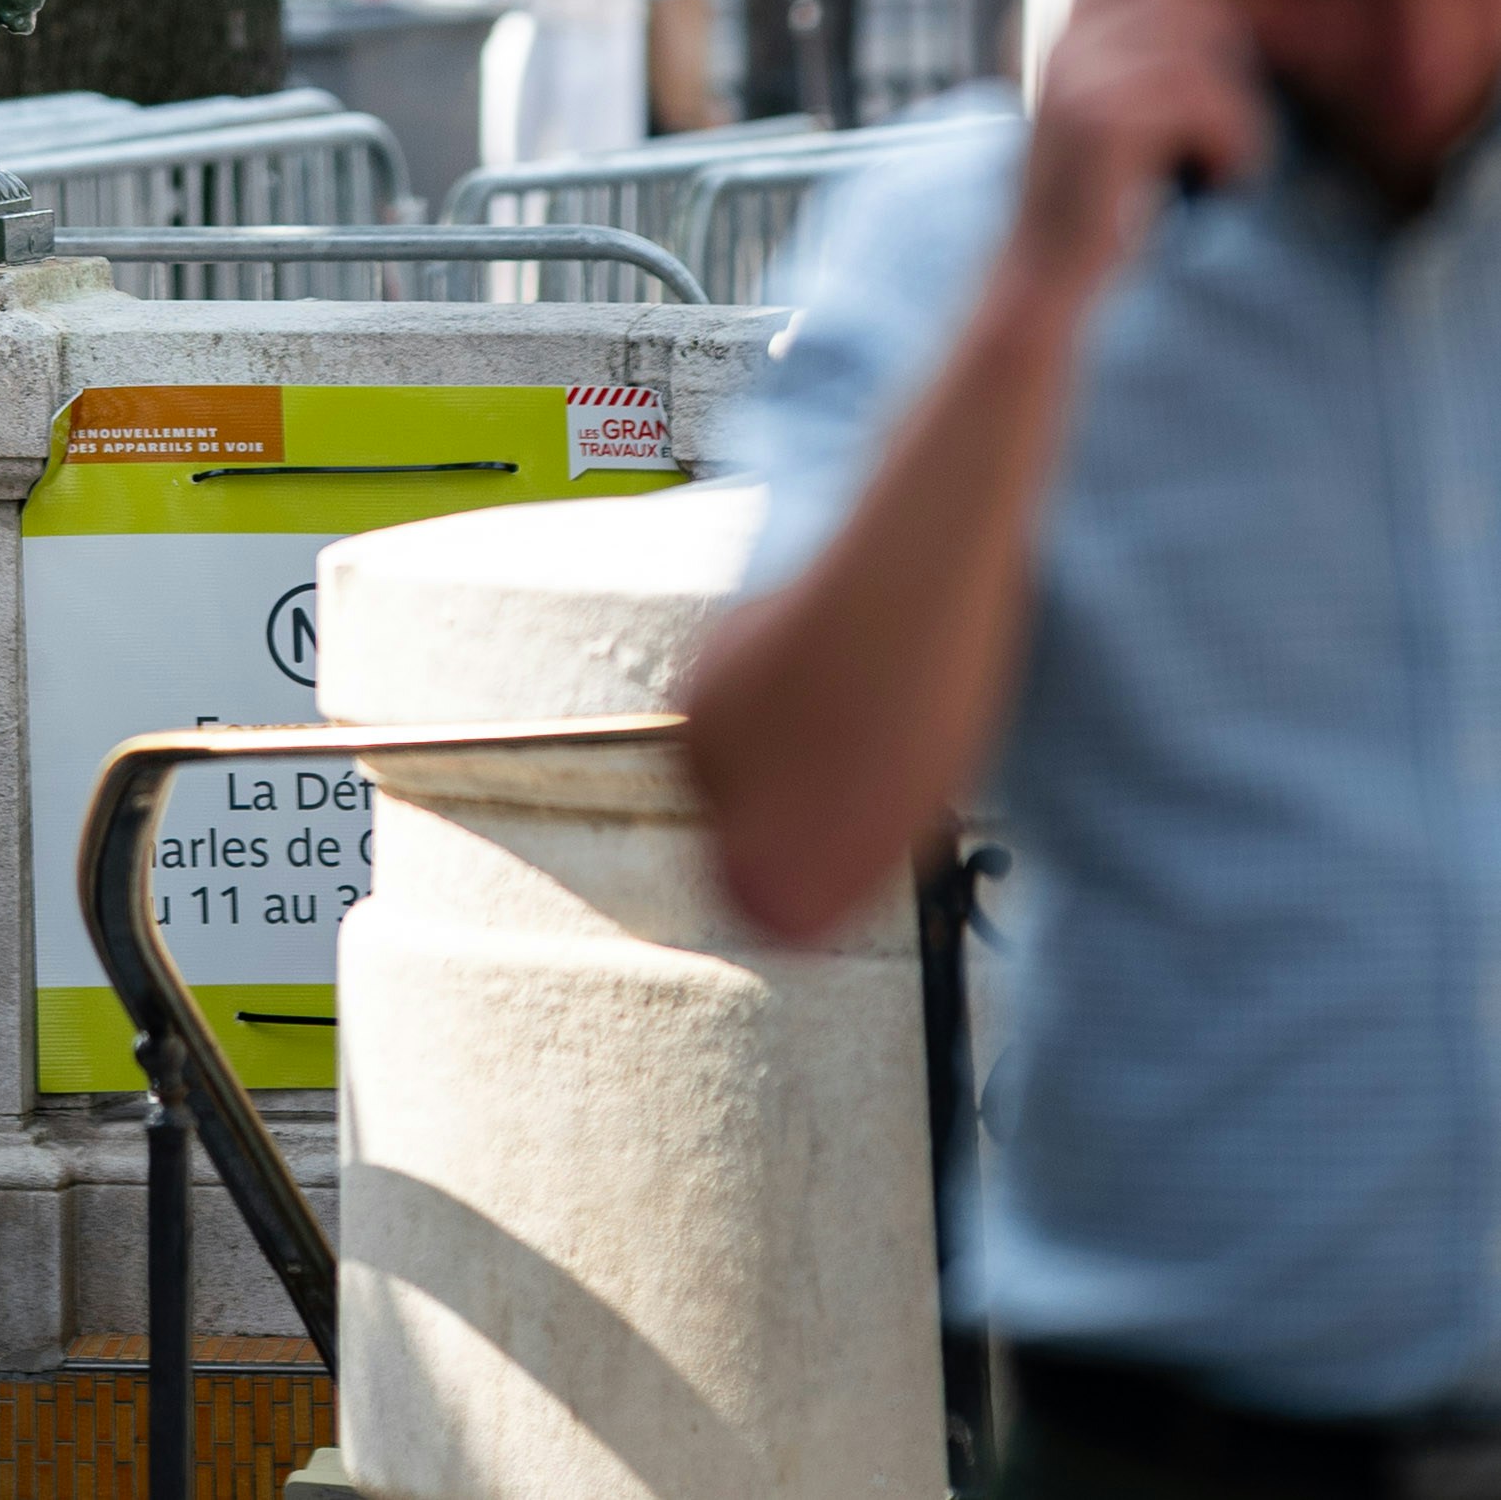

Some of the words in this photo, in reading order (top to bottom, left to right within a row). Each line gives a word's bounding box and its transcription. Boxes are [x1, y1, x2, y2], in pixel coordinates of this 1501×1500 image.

[578, 429, 599, 439] LES
[68, 443, 98, 454] DES
[103, 442, 193, 454] APPAREILS
[198, 442, 220, 452] DE
[224, 442, 264, 452] VOIE
[579, 442, 659, 457] TRAVAUX
[227, 772, 278, 811] La
[287, 827, 341, 868] de
[191, 886, 239, 924] 11
[264, 893, 317, 924] au
